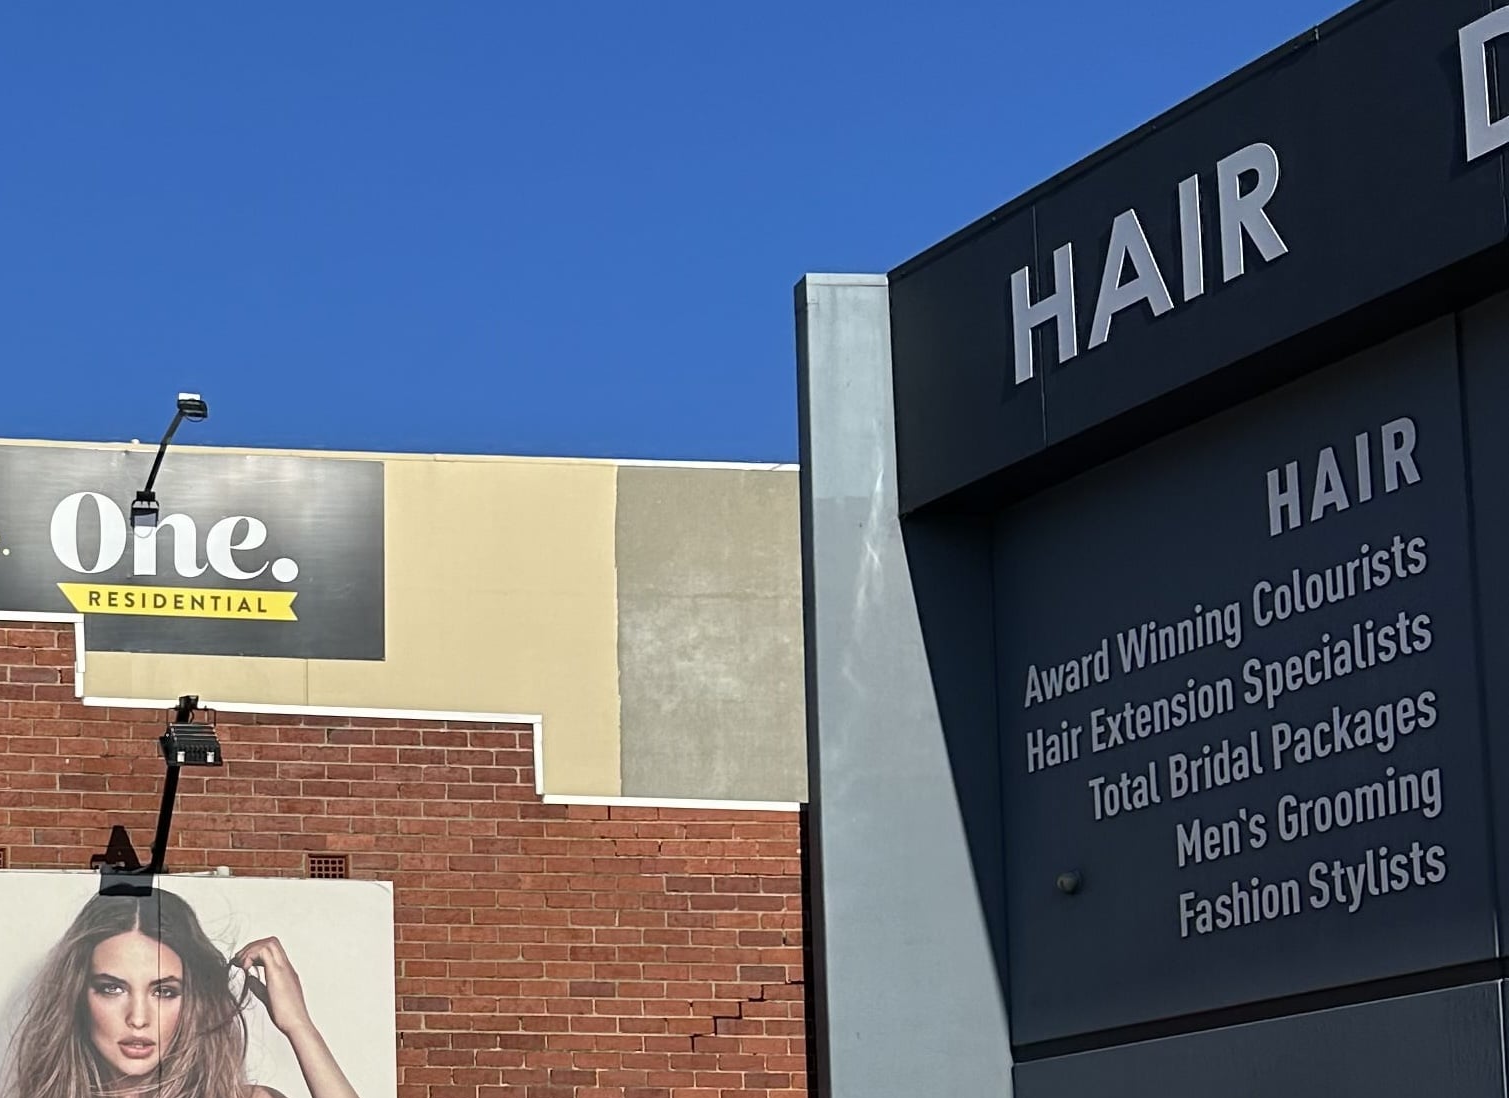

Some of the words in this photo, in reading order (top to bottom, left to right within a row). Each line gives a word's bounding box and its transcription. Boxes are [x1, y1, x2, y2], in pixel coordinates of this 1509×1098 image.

[1011, 142, 1288, 385] HAIR
[50, 491, 299, 583] One.
[1267, 416, 1421, 537] HAIR
[89, 590, 268, 614] RESIDENTIAL
[1024, 638, 1110, 708] Award
[1117, 601, 1242, 673] Winning
[1253, 534, 1428, 627] Colourists
[1027, 720, 1082, 773] Hair
[1091, 678, 1233, 753] Extension
[1243, 610, 1433, 709] Specialists
[1088, 761, 1160, 820] Total
[1169, 730, 1263, 800] Bridal
[1272, 690, 1438, 771] Packages
[1176, 807, 1267, 867] Men's
[1277, 767, 1442, 841] Grooming
[1179, 877, 1301, 938] Fashion
[1308, 840, 1447, 912] Stylists
